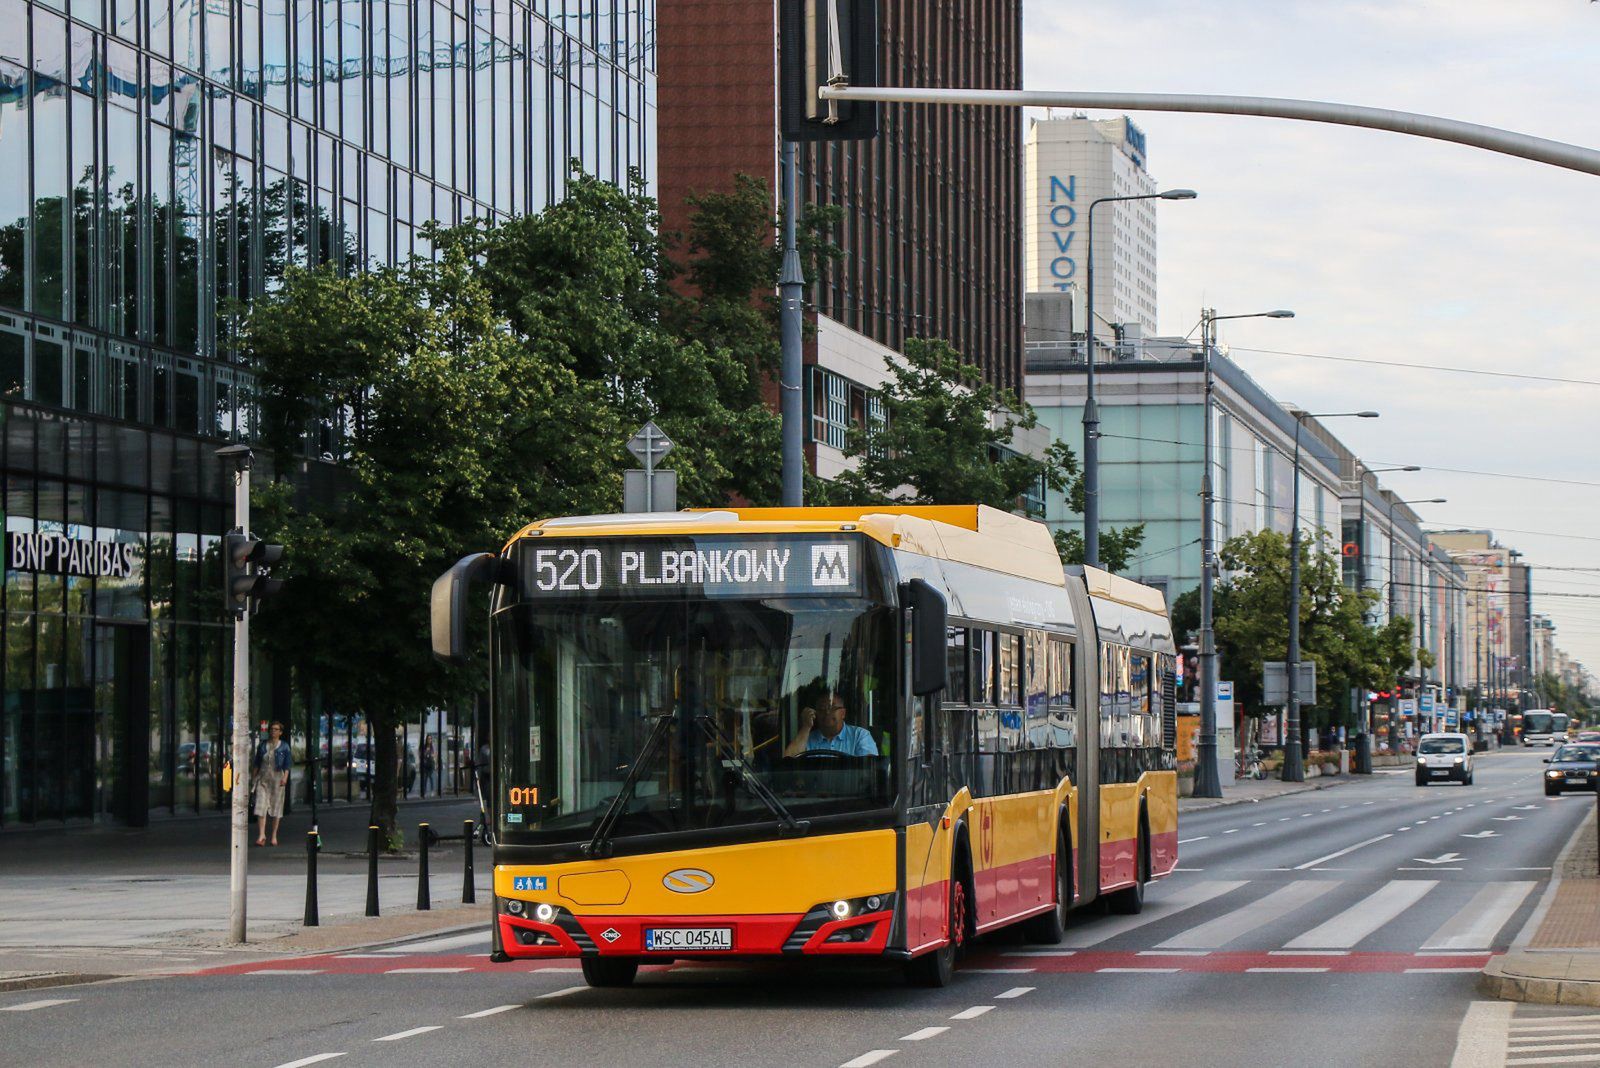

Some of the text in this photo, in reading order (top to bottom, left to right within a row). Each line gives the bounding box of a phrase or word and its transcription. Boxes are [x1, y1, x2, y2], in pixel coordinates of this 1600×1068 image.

[12, 532, 133, 578] BNP PARIBAS
[536, 548, 791, 591] 520 PL.BANKOWY
[510, 787, 538, 805] 011
[654, 930, 729, 945] WSC 045AL
